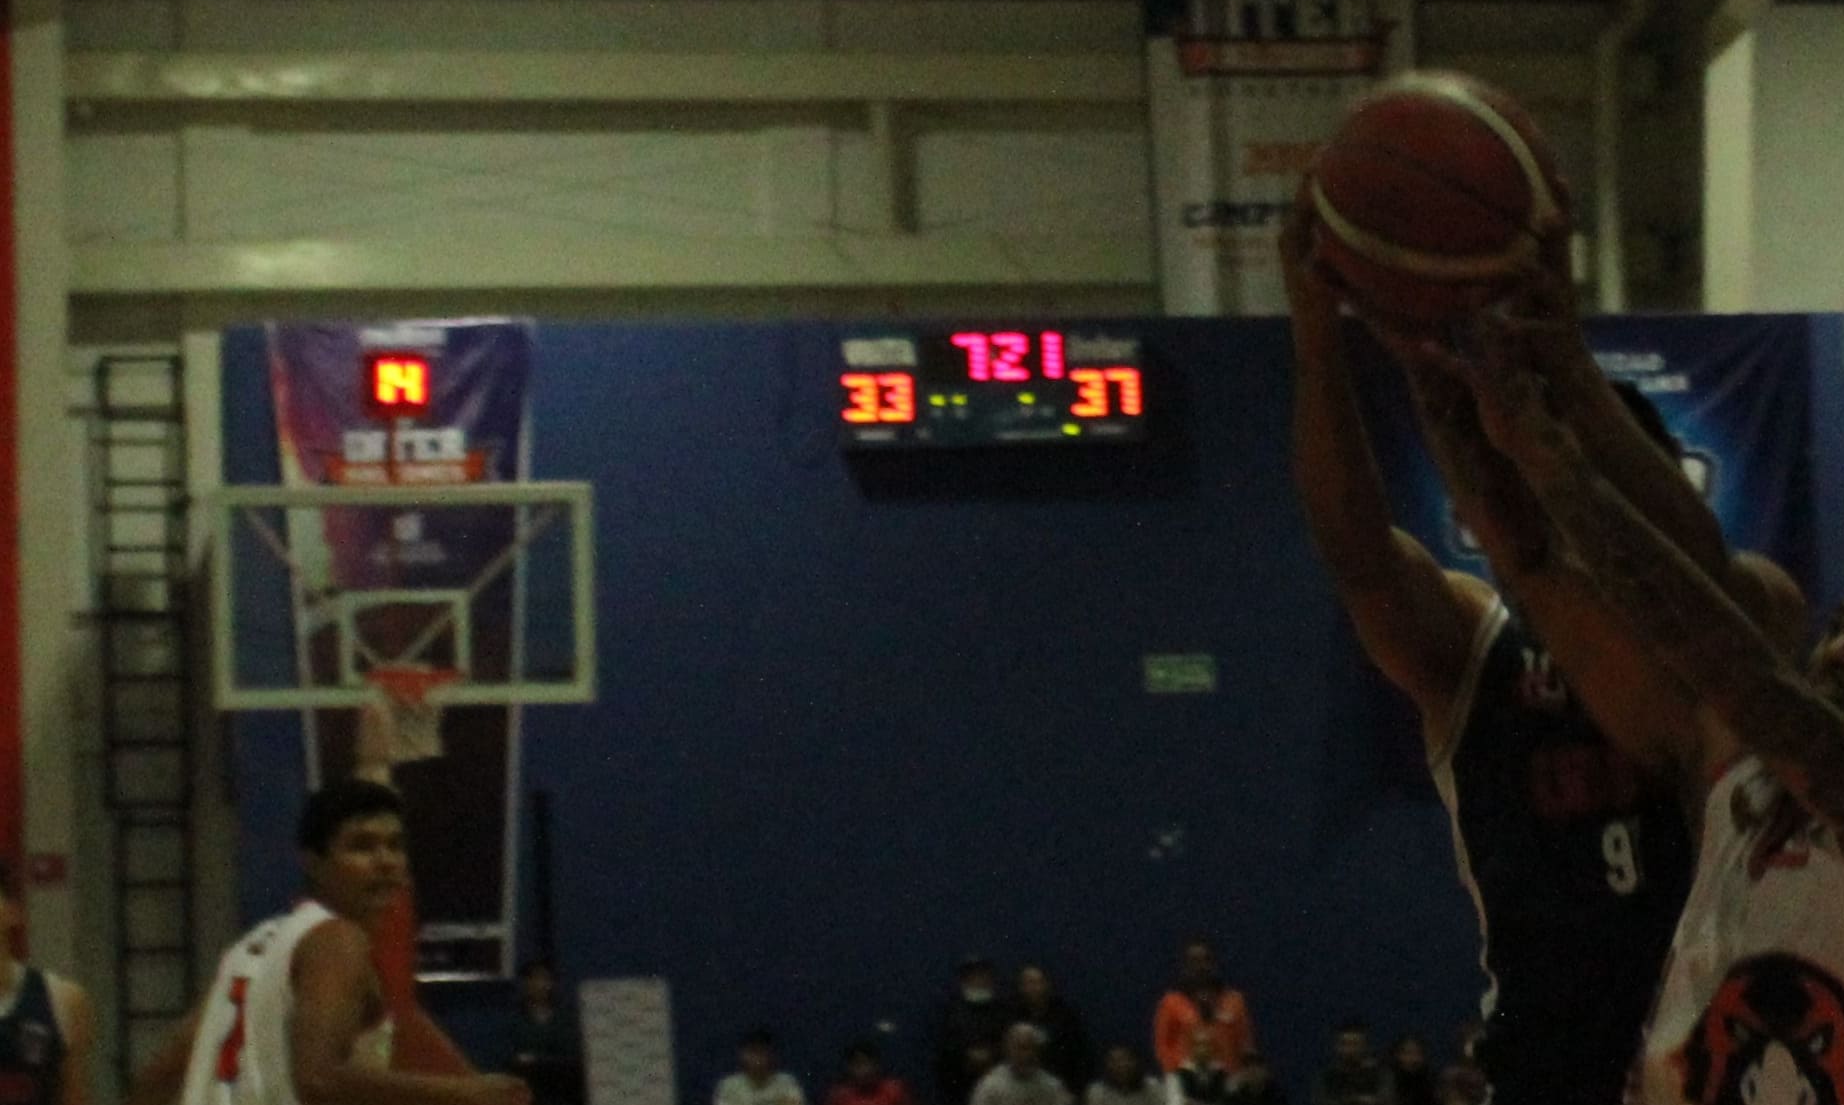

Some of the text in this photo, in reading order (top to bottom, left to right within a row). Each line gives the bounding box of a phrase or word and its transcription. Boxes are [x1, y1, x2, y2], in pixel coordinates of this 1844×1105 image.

[839, 370, 916, 424] 33
[1067, 366, 1144, 417] 37
[1600, 821, 1640, 896] 9
